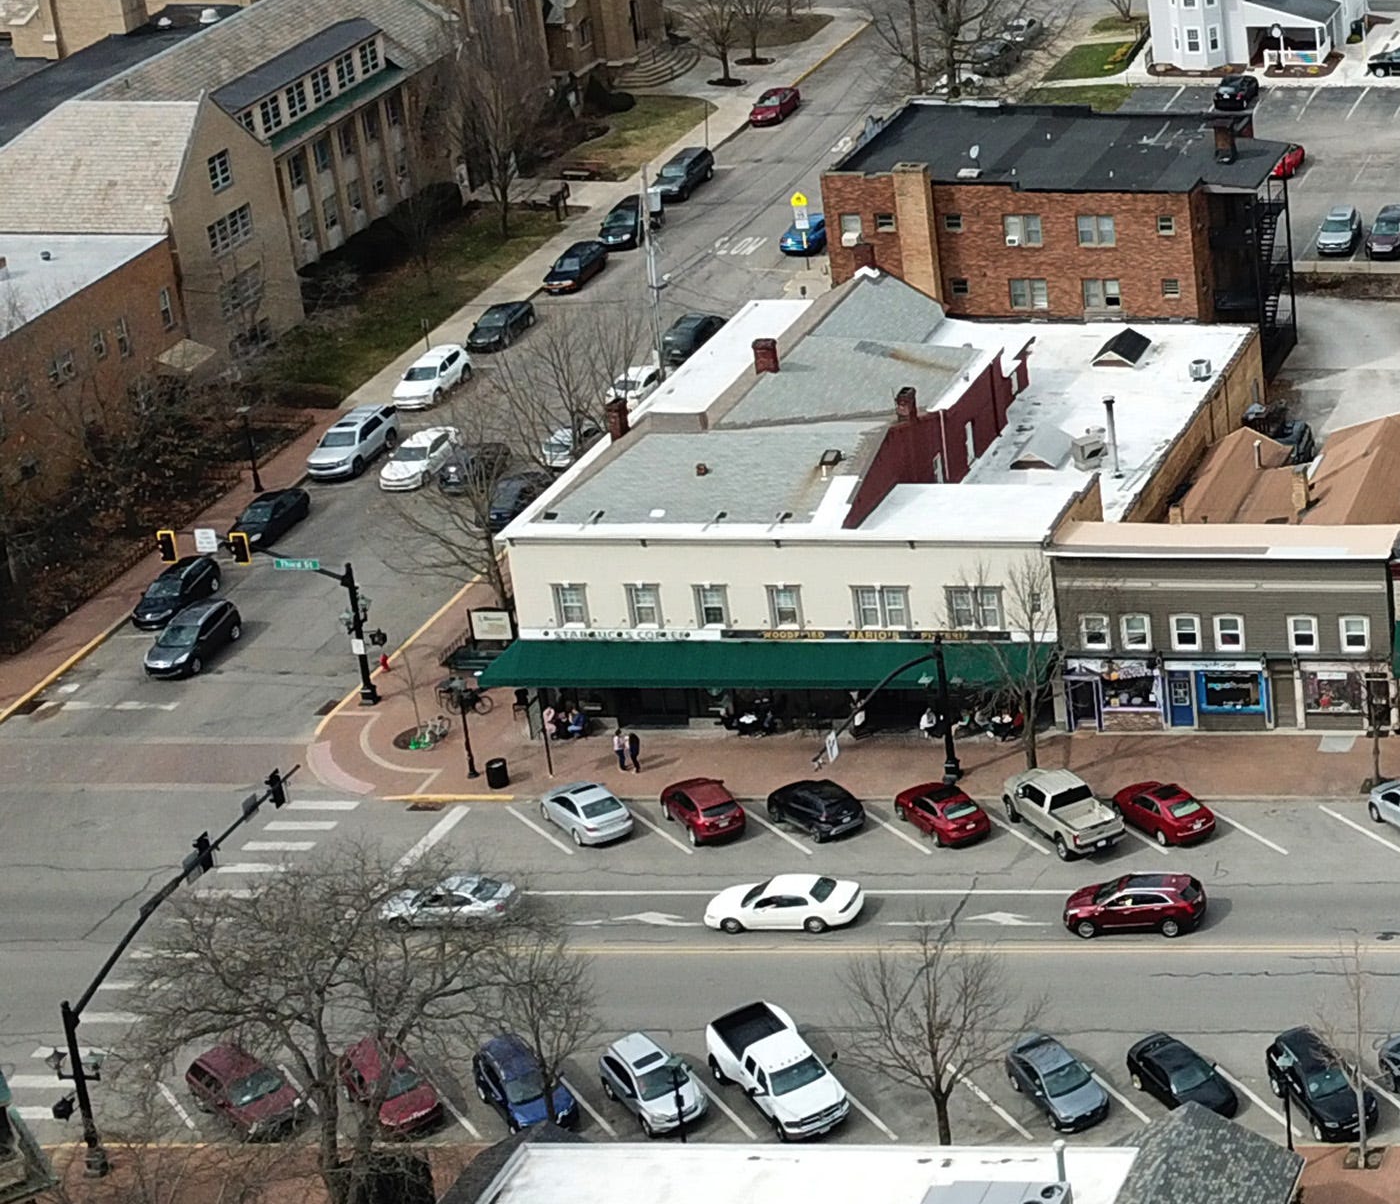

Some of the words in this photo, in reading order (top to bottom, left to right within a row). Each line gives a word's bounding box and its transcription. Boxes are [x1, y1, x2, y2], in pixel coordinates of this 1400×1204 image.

[280, 559, 302, 568] Third
[554, 631, 632, 639] STARUCS
[637, 631, 687, 640] COFEE
[763, 631, 825, 640] WOODFED
[921, 632, 969, 640] PIERIA
